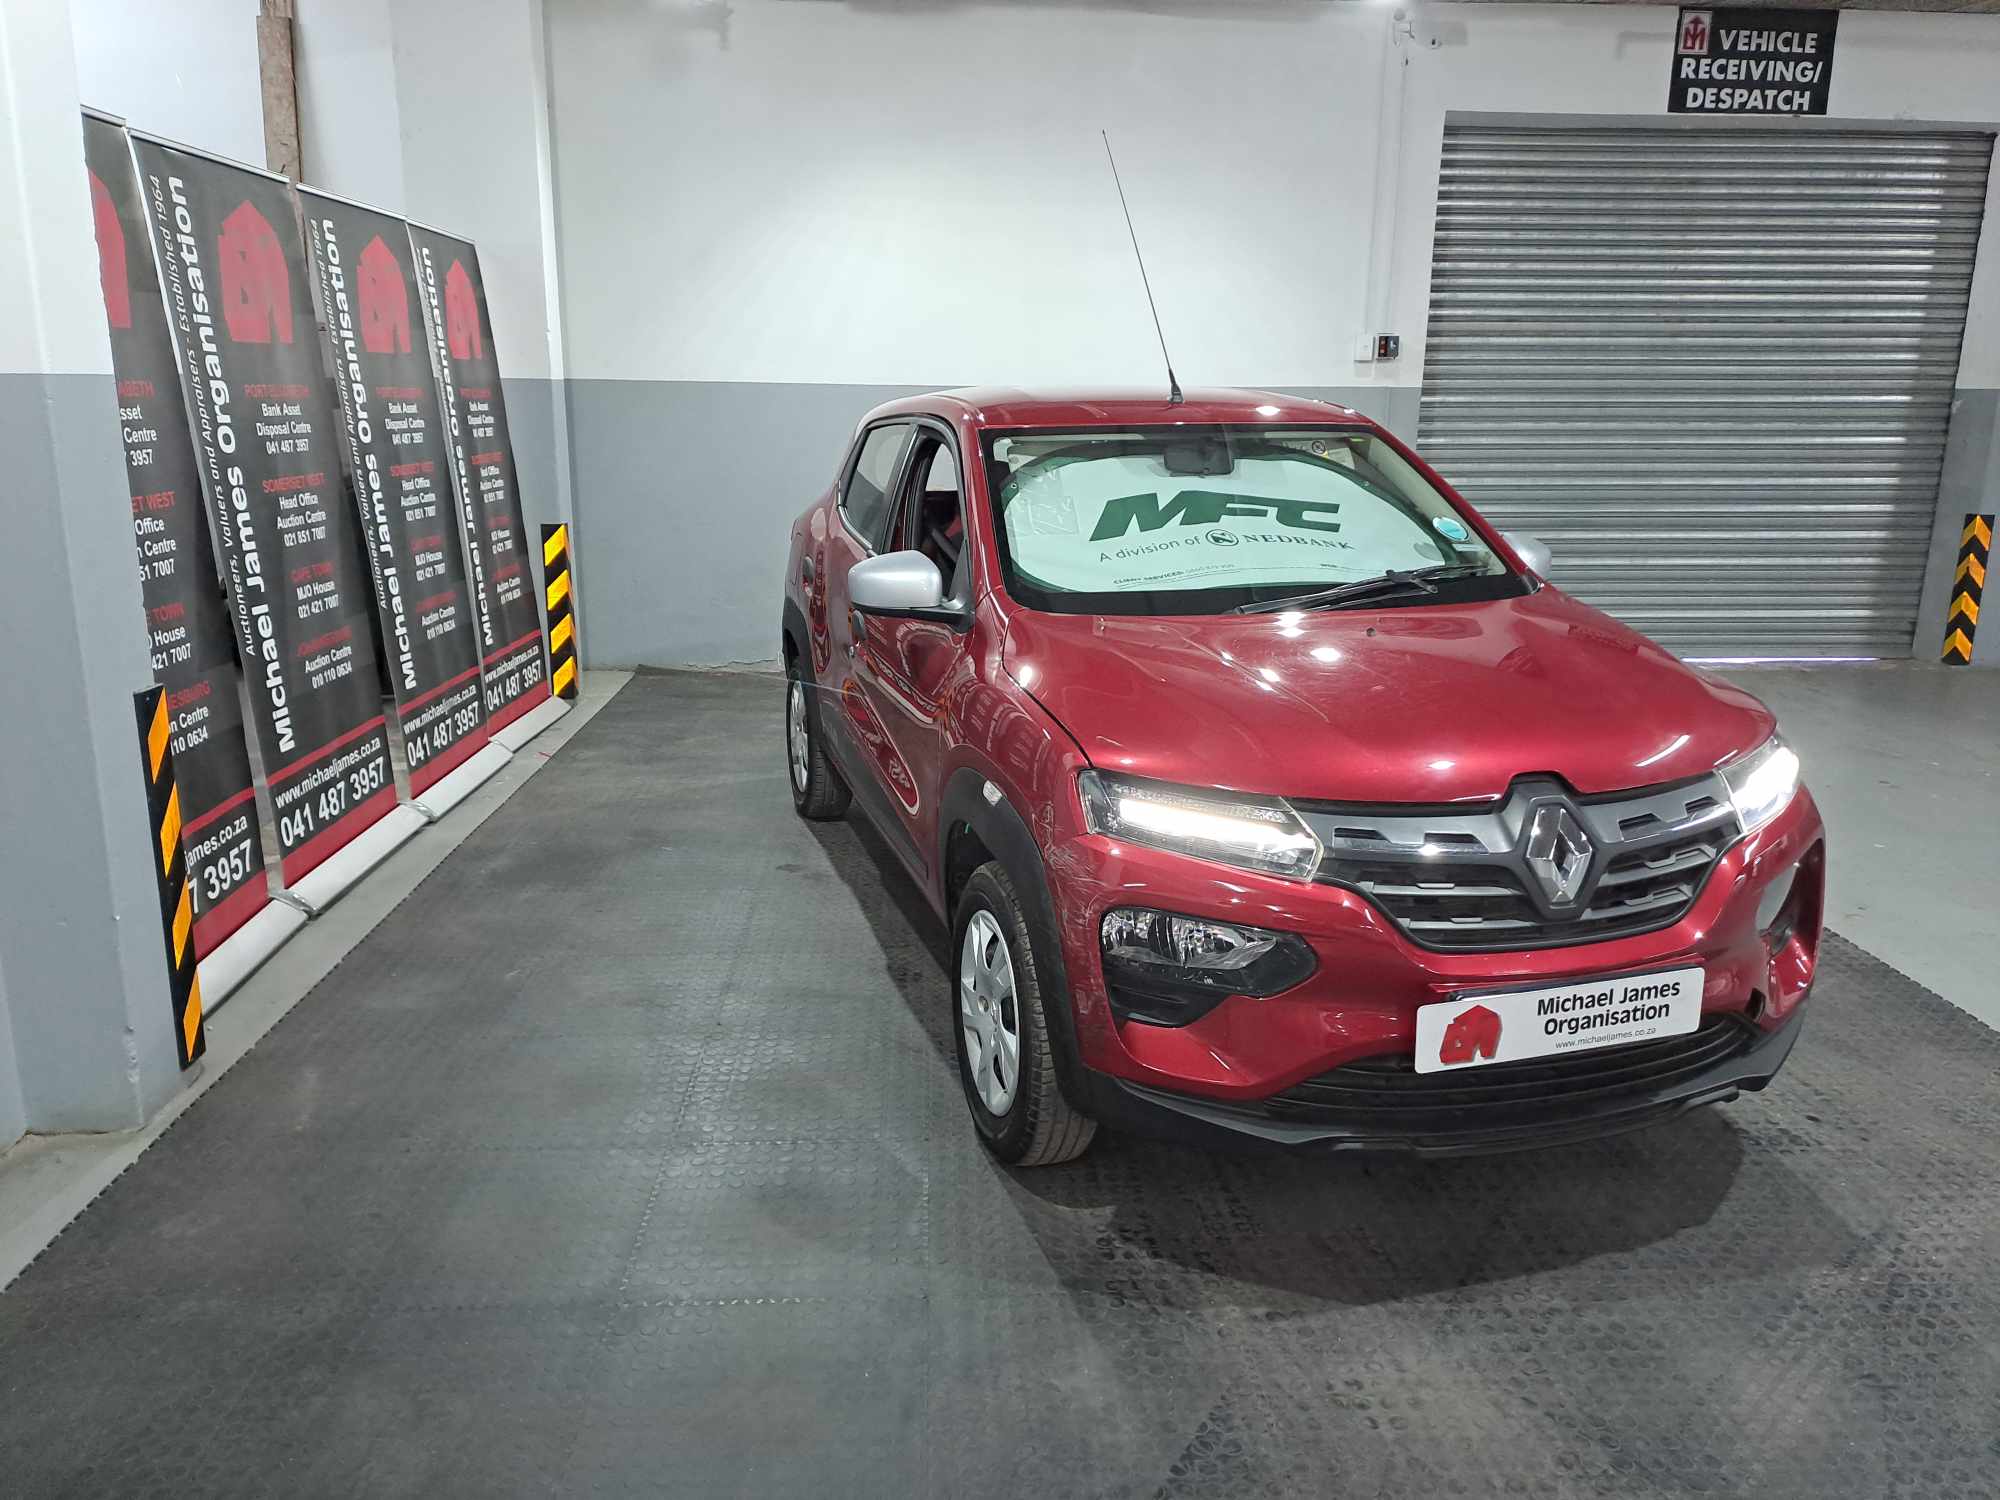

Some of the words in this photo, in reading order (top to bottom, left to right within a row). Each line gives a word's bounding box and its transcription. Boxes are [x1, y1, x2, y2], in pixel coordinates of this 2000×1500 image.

[1719, 29, 1818, 54] VEHICLE
[1680, 57, 1823, 84] RECEIVING/
[1686, 87, 1811, 112] DESPATCH
[149, 174, 168, 221] 1964
[160, 227, 191, 332] Established
[168, 176, 236, 455] Organisation
[322, 219, 371, 444] Organisation
[422, 247, 459, 437] Organisation
[186, 349, 213, 442] Appraisers
[261, 403, 282, 417] Bank
[123, 427, 158, 444] Centre
[256, 422, 290, 439] Disposal
[130, 449, 153, 467] 3957
[266, 440, 280, 455] 041
[204, 446, 220, 480] and
[279, 496, 298, 510] Head
[299, 493, 319, 507] Office
[456, 445, 476, 534] James
[364, 453, 394, 558] James
[1089, 489, 1341, 542] MFC
[135, 518, 166, 536] Office
[227, 466, 265, 593] James
[277, 514, 305, 530] Auction
[144, 538, 177, 558] Centre
[284, 532, 297, 547] 021
[297, 529, 311, 544] 851
[1099, 551, 1112, 562] A
[1115, 539, 1181, 559] division
[1184, 534, 1202, 546] of
[1244, 533, 1355, 550] NEDBANK
[153, 558, 175, 579] 7007
[312, 581, 336, 596] House
[470, 541, 494, 646] Michael
[297, 605, 311, 619] 021
[154, 625, 187, 648] House
[383, 567, 417, 690] Michael
[151, 653, 169, 672] 421
[170, 642, 192, 664] 7007
[305, 654, 331, 673] Auction
[251, 603, 296, 753] Michael
[486, 683, 504, 711] 041
[505, 672, 520, 699] 487
[522, 660, 541, 688] 3957
[179, 705, 209, 731] Centre
[187, 725, 209, 749] 0634
[407, 732, 431, 767] 041
[433, 718, 453, 750] 487
[454, 700, 479, 736] 3957
[275, 737, 381, 809] www.michaeljames.co.za
[280, 802, 314, 847] 041
[318, 781, 346, 820] 487
[350, 756, 384, 800] 3957
[203, 838, 252, 900] 3957
[1537, 988, 1614, 1017] Michael
[1619, 979, 1681, 1005] James
[1544, 1000, 1671, 1037] Organisation
[1555, 1026, 1657, 1050] www.michaeljames.co.za
